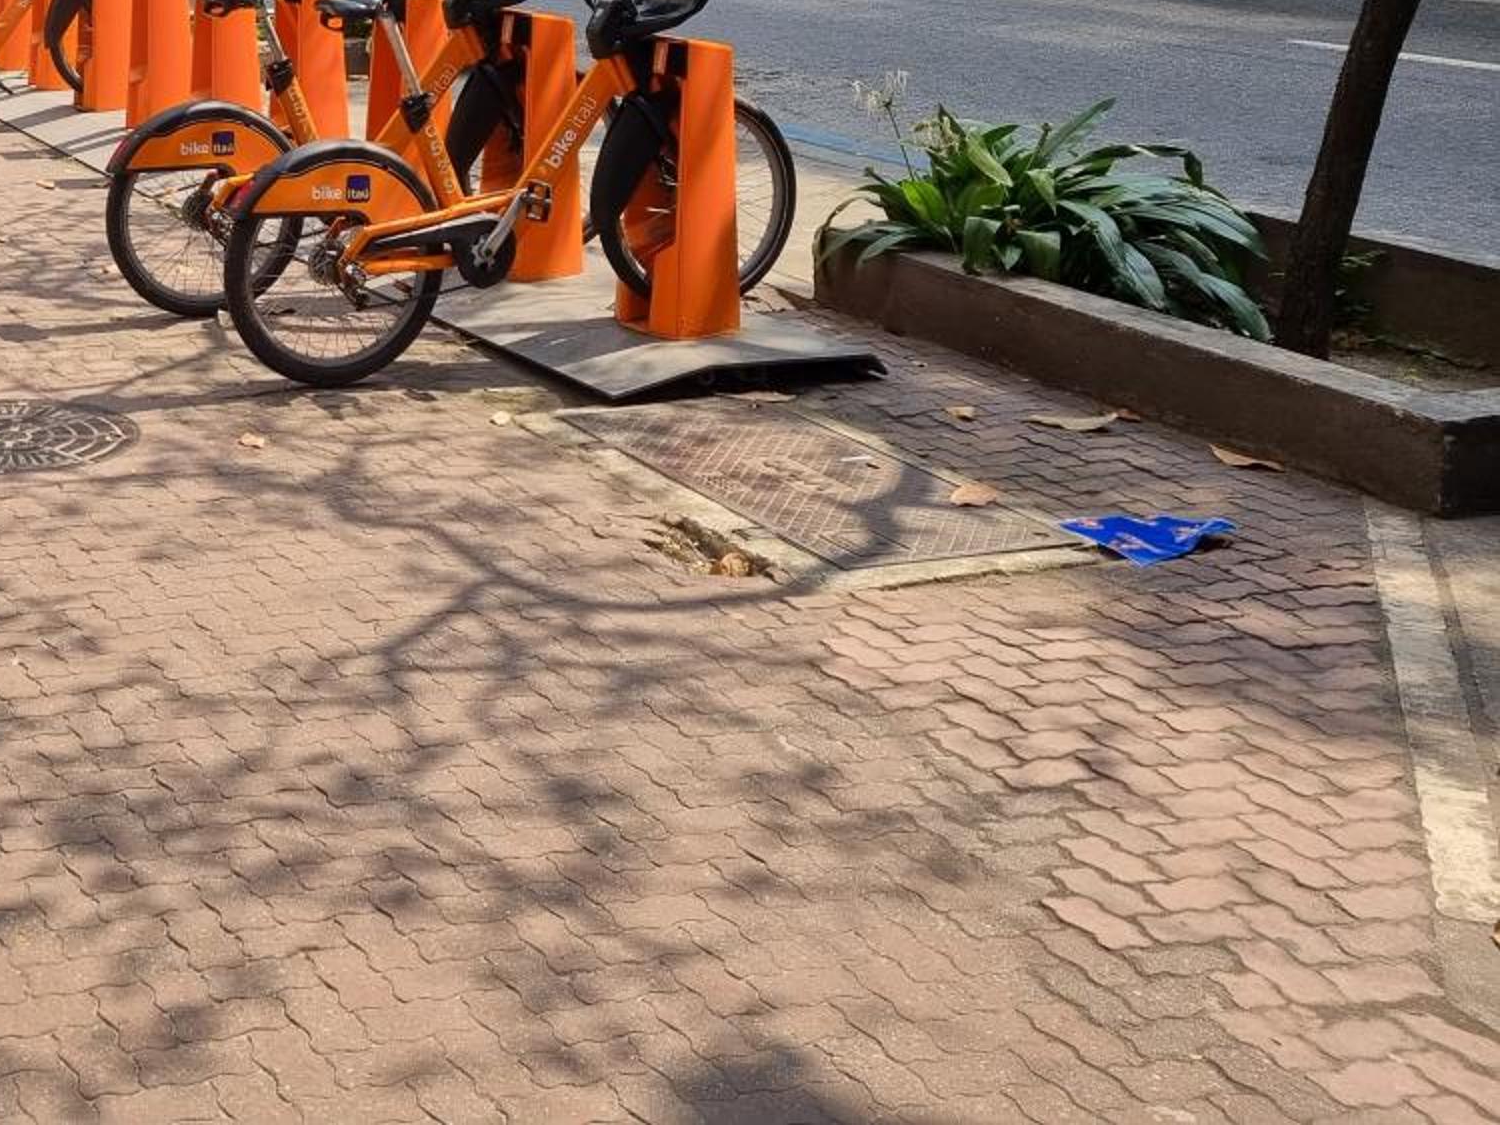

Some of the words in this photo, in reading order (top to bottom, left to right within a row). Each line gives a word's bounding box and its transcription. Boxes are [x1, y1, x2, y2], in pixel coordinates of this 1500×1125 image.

[545, 127, 579, 169] bike
[571, 92, 598, 132] itaú
[180, 142, 210, 155] bike
[311, 186, 342, 200] bike
